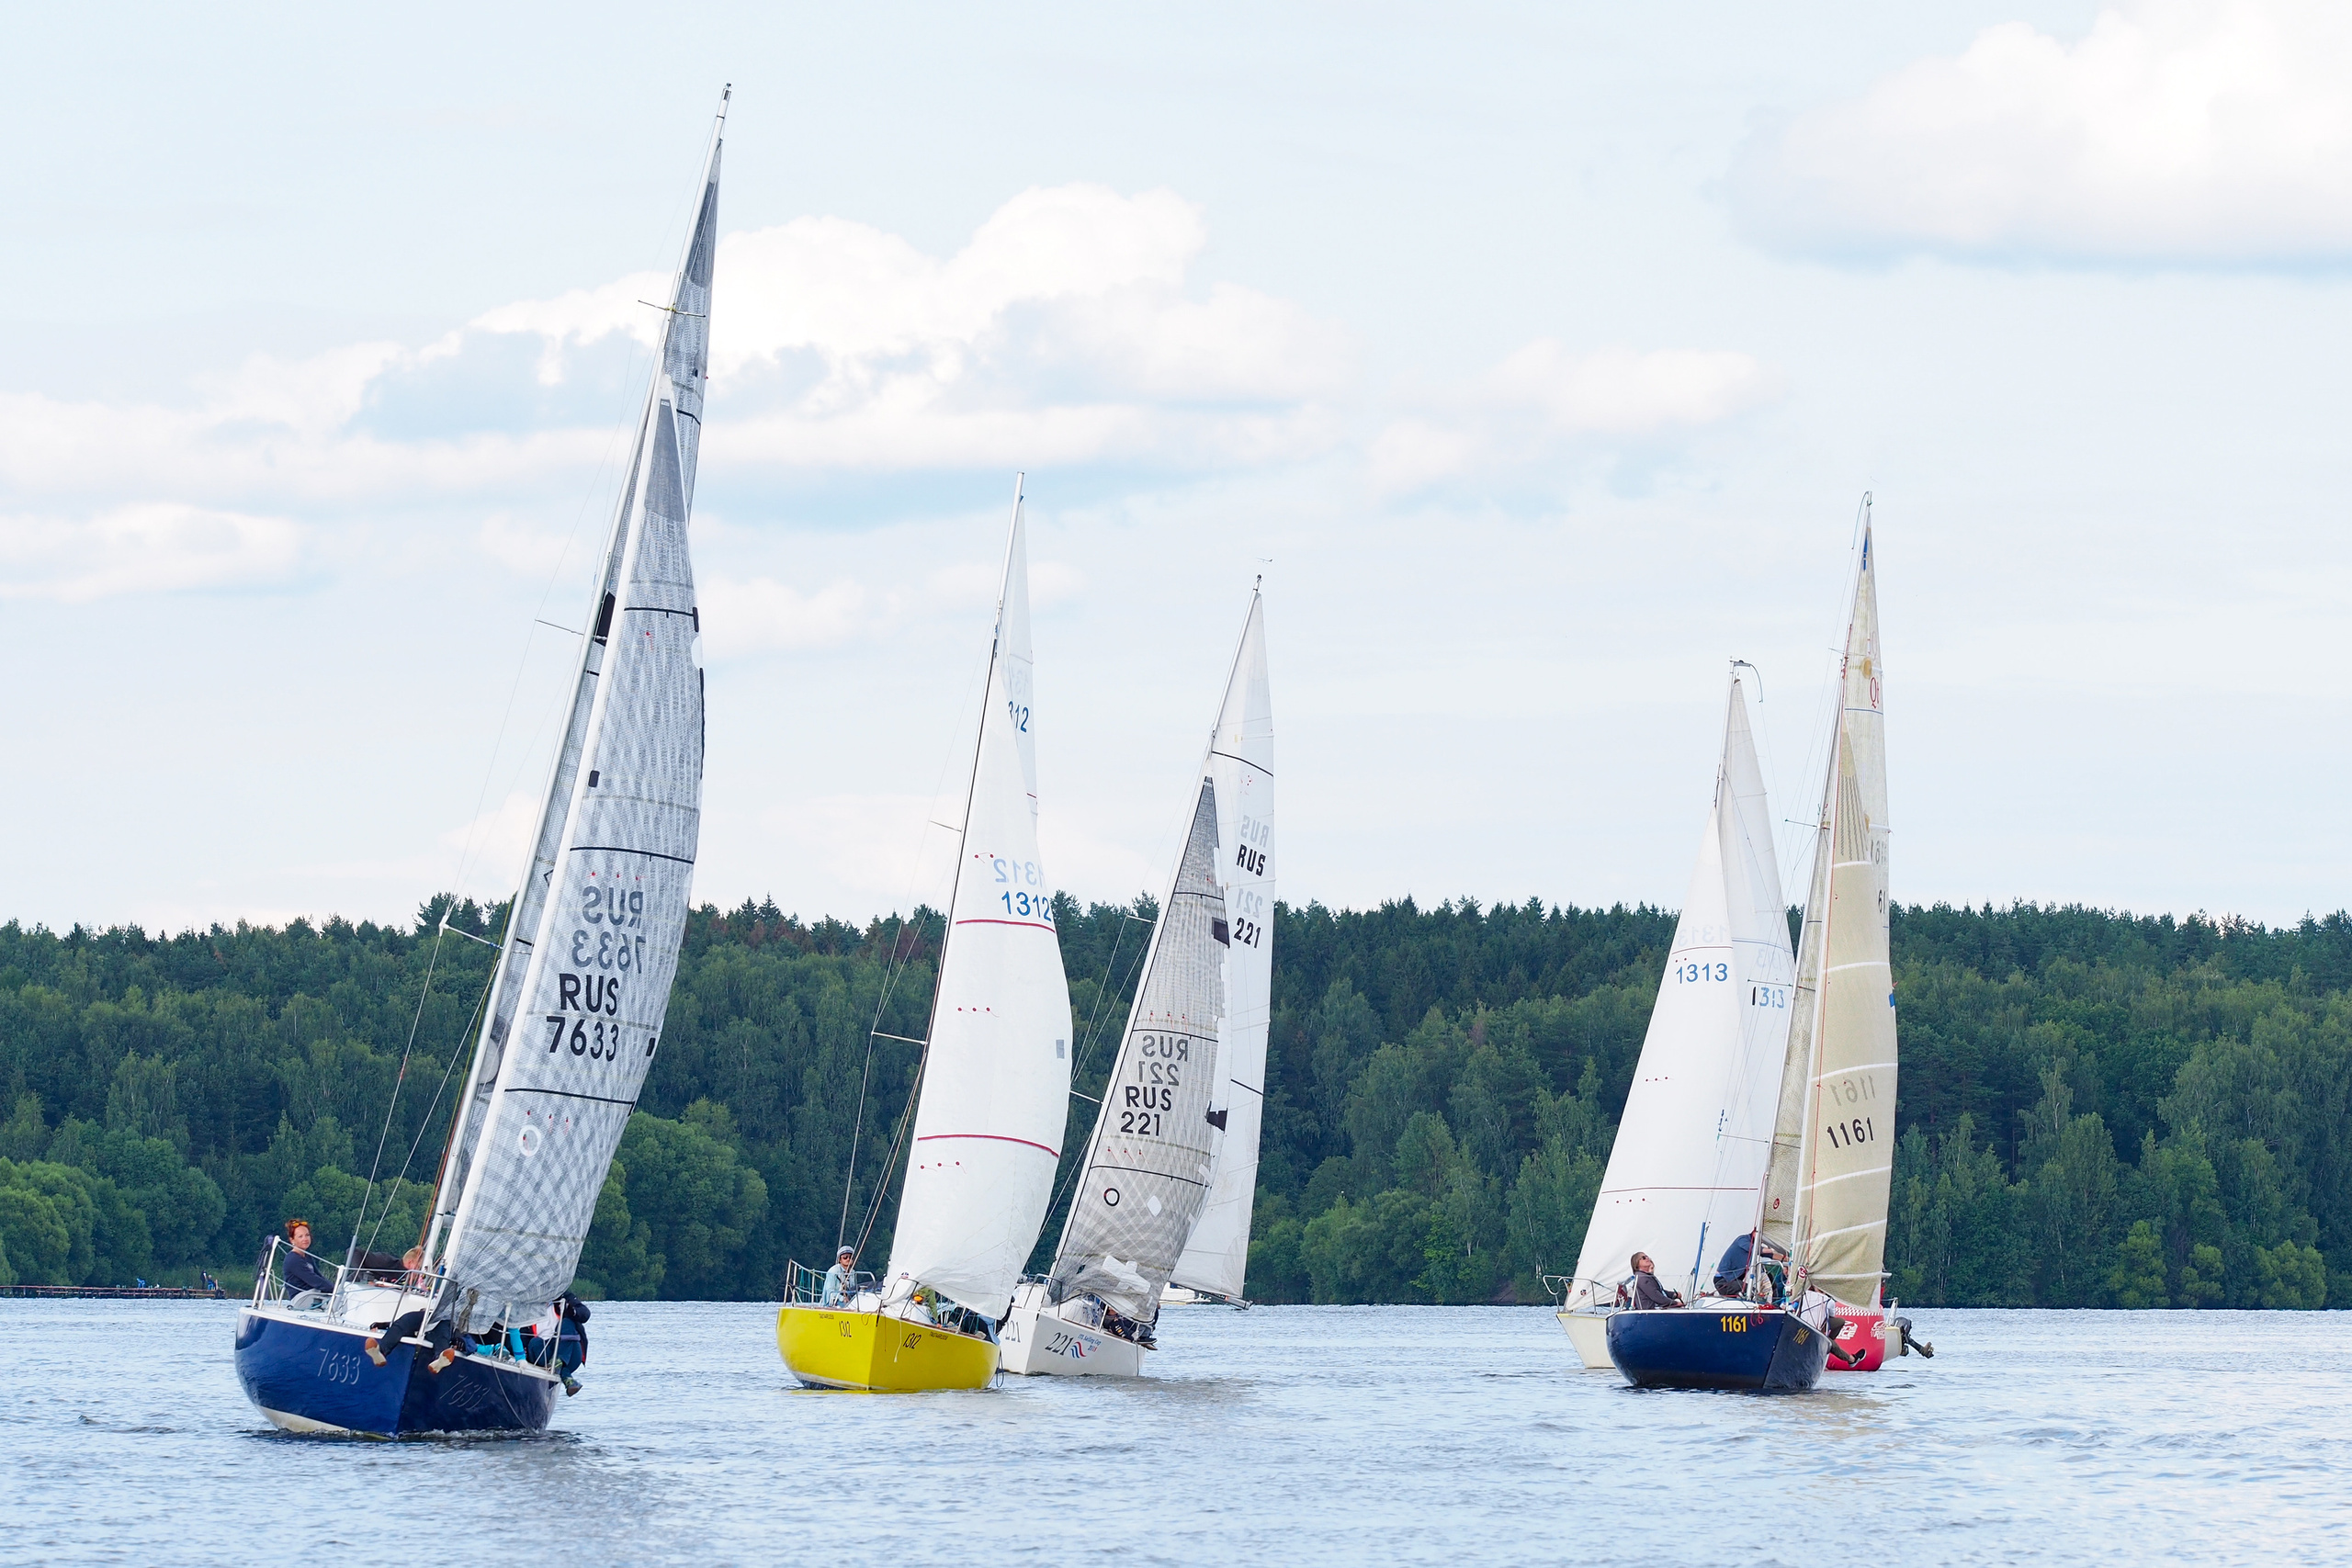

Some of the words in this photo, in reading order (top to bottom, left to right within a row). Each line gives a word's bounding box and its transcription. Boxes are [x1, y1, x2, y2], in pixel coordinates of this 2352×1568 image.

[1008, 700, 1029, 733] 312
[1236, 843, 1267, 877] RUS
[1001, 890, 1052, 922] 1312
[1233, 917, 1261, 949] 221
[1676, 963, 1728, 985] 1313
[559, 973, 619, 1017] RUS
[1751, 986, 1785, 1009] 1313
[546, 1015, 619, 1062] 7633
[1125, 1085, 1172, 1111] RUS
[1120, 1111, 1160, 1136] 221
[1826, 1116, 1874, 1149] 1161
[1005, 1319, 1021, 1343] 221
[1720, 1315, 1747, 1333] 1161
[1792, 1326, 1811, 1346] 1161
[902, 1332, 922, 1349] 1312
[1044, 1332, 1074, 1356] 221
[317, 1348, 361, 1385] 7633
[439, 1373, 492, 1411] 7633
